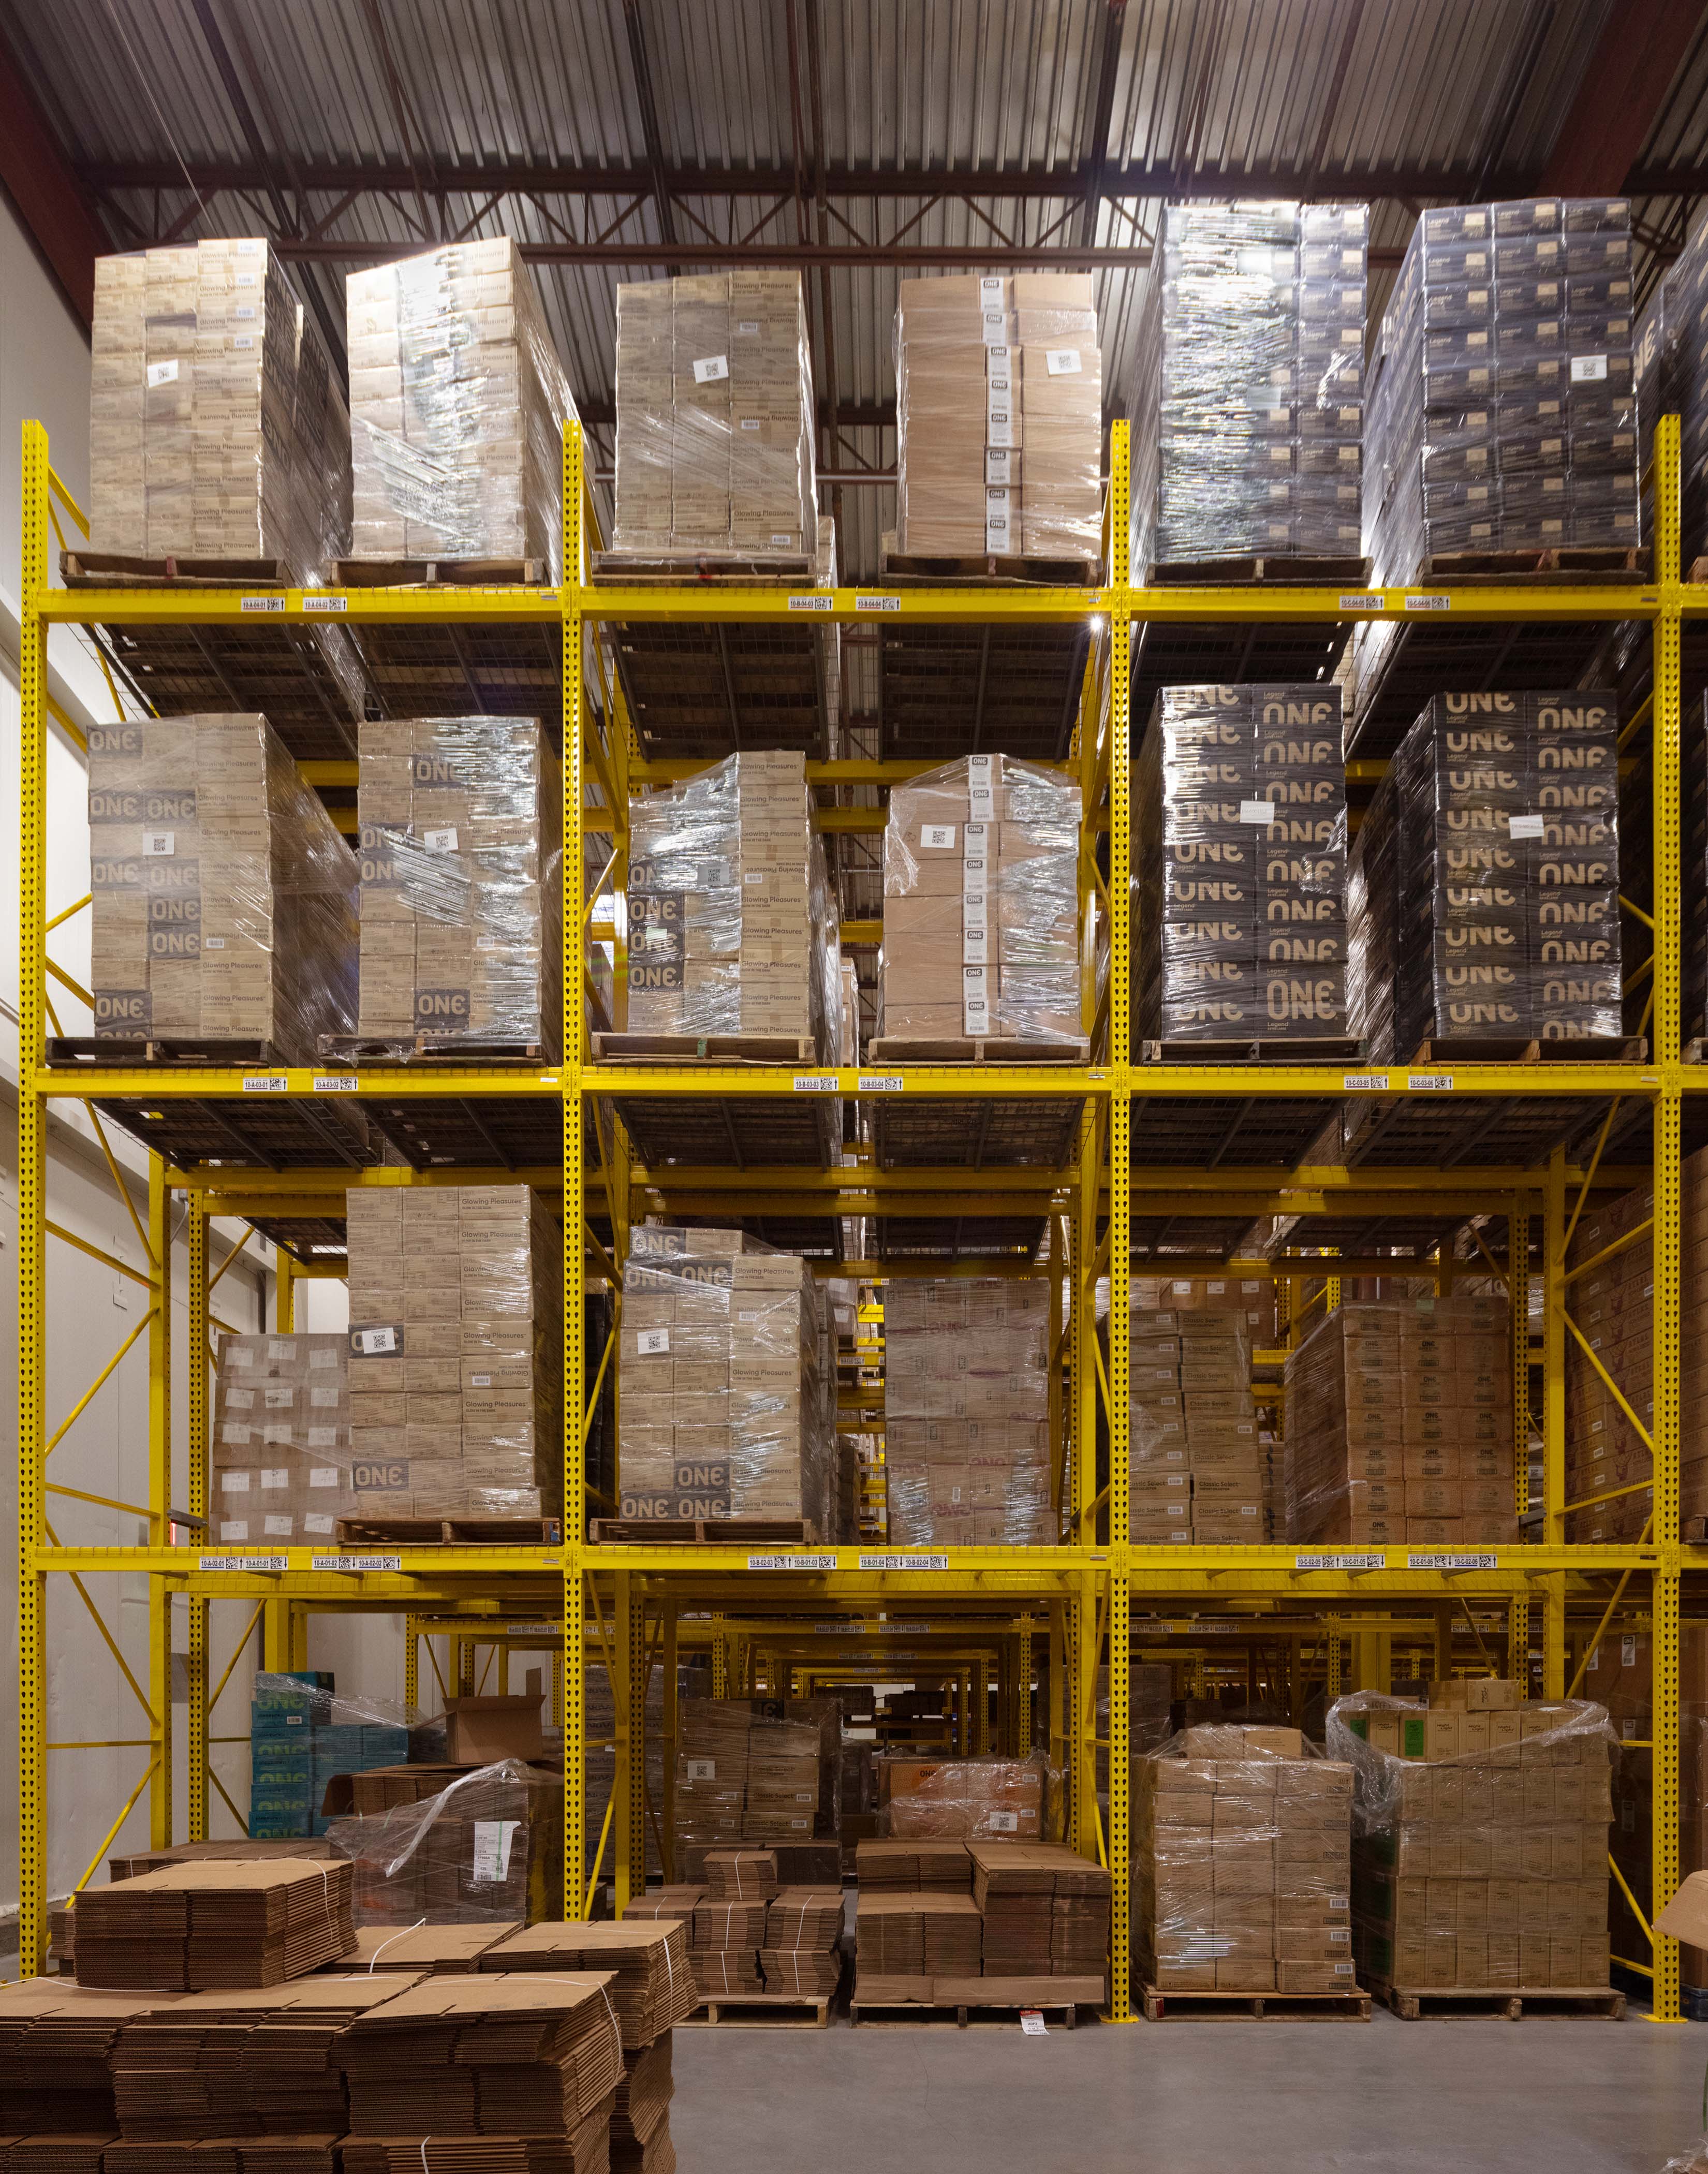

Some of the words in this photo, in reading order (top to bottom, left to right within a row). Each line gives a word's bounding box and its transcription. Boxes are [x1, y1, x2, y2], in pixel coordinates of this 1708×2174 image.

[89, 730, 137, 751] ONE
[91, 797, 137, 817] ONE
[148, 799, 195, 818] ONE
[630, 901, 676, 920] ONE
[152, 933, 199, 953] ONE
[630, 967, 676, 987] ONE
[97, 998, 144, 1018] ONE
[419, 995, 465, 1015] ONE
[356, 1466, 403, 1486] ONE
[678, 1467, 724, 1486] ONE
[622, 1499, 669, 1518] ONE
[679, 1499, 725, 1518] ONE
